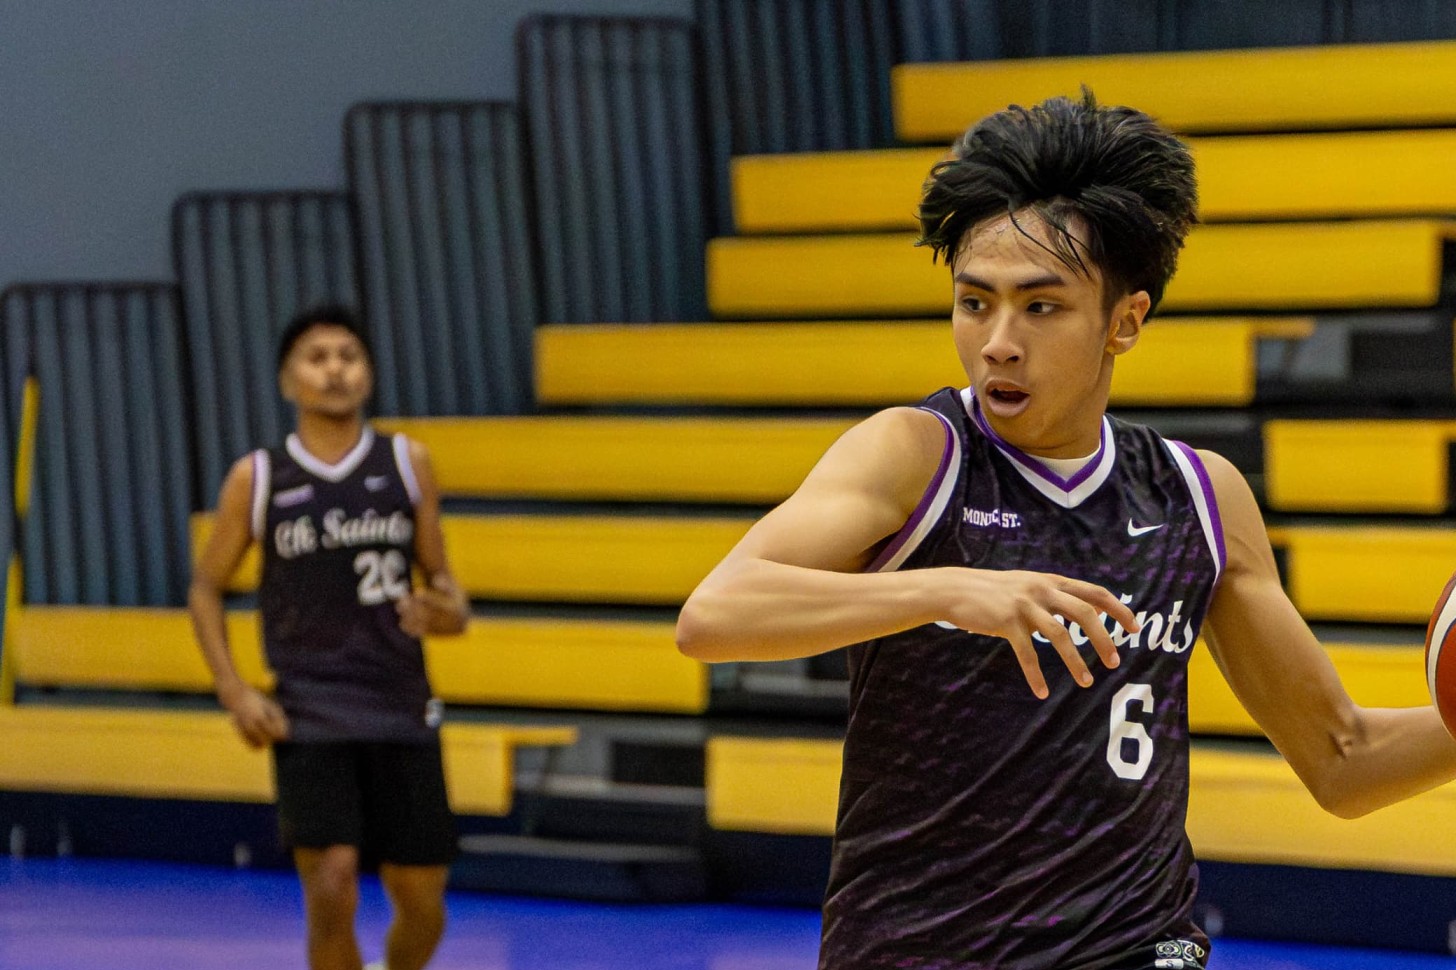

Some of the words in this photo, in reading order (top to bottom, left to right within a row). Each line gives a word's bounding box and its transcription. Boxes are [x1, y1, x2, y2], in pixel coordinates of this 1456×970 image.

[1002, 512, 1021, 528] ST.
[1032, 593, 1194, 653] aints
[1107, 683, 1154, 780] 6
